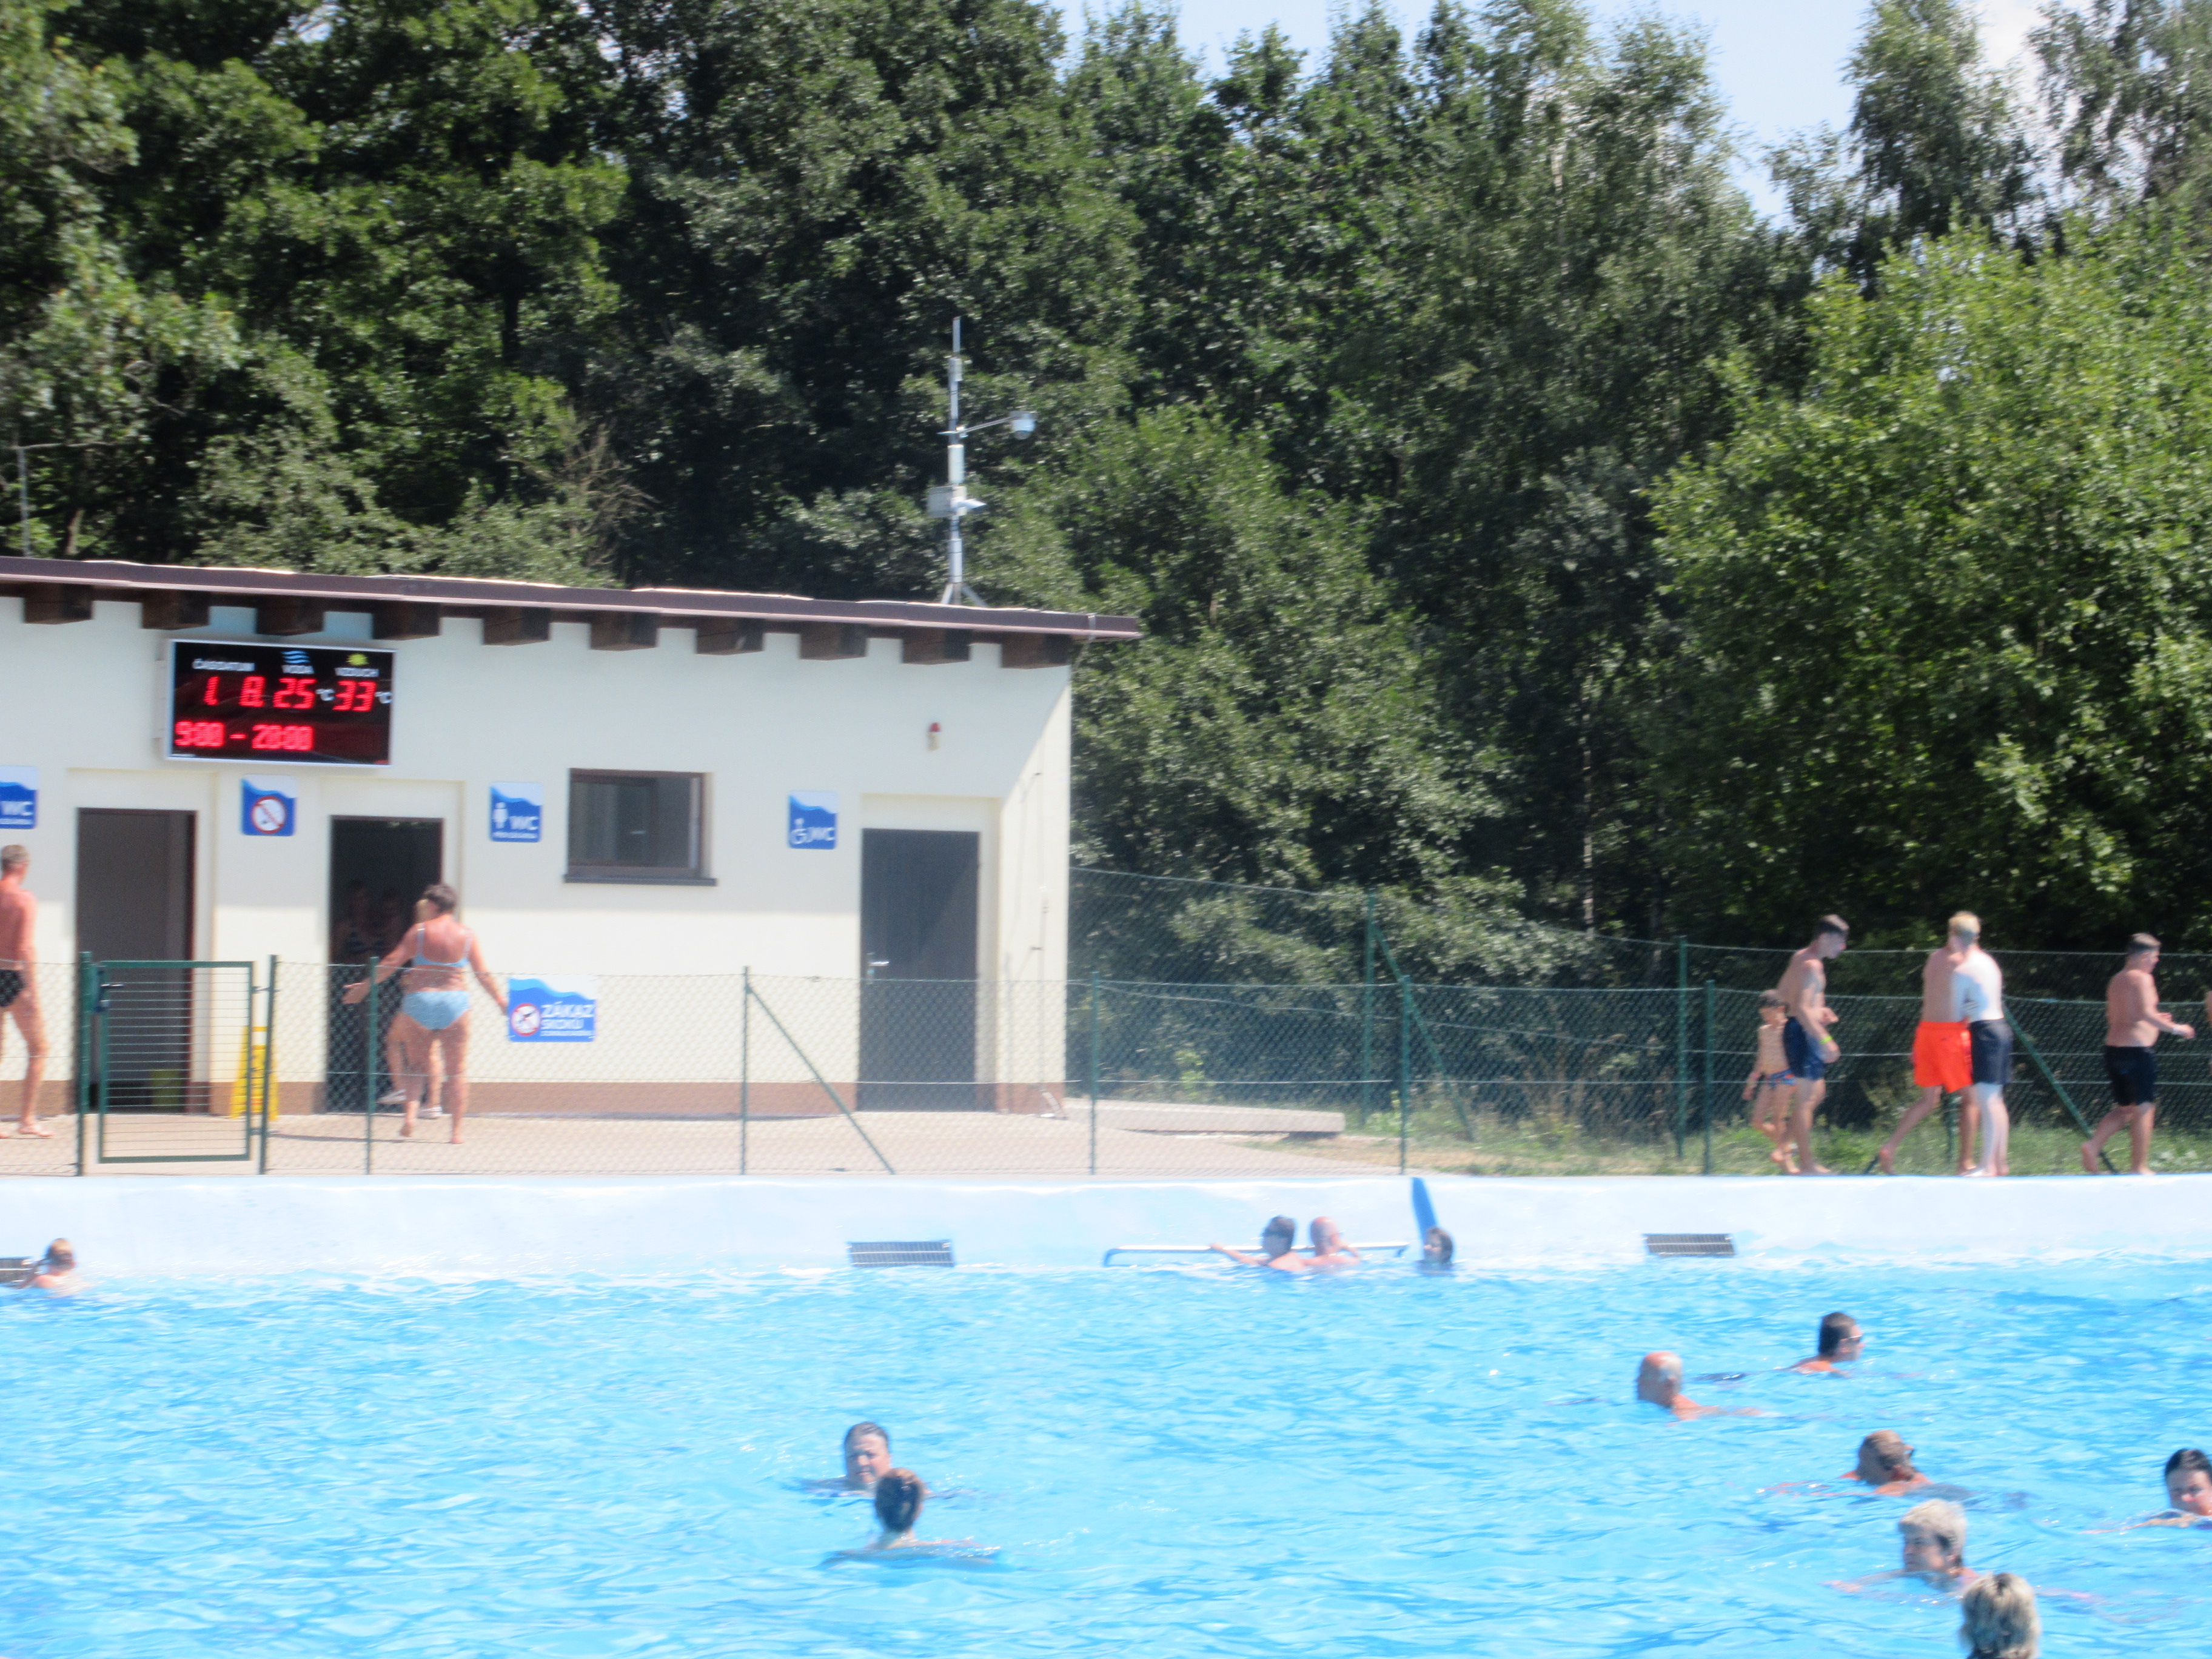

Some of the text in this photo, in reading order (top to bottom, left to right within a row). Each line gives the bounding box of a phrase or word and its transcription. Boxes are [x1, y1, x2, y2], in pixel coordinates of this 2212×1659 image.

[272, 677, 317, 709] 25
[510, 816, 538, 830] WC
[808, 826, 835, 841] WC
[540, 1001, 595, 1018] ZÁKAZ
